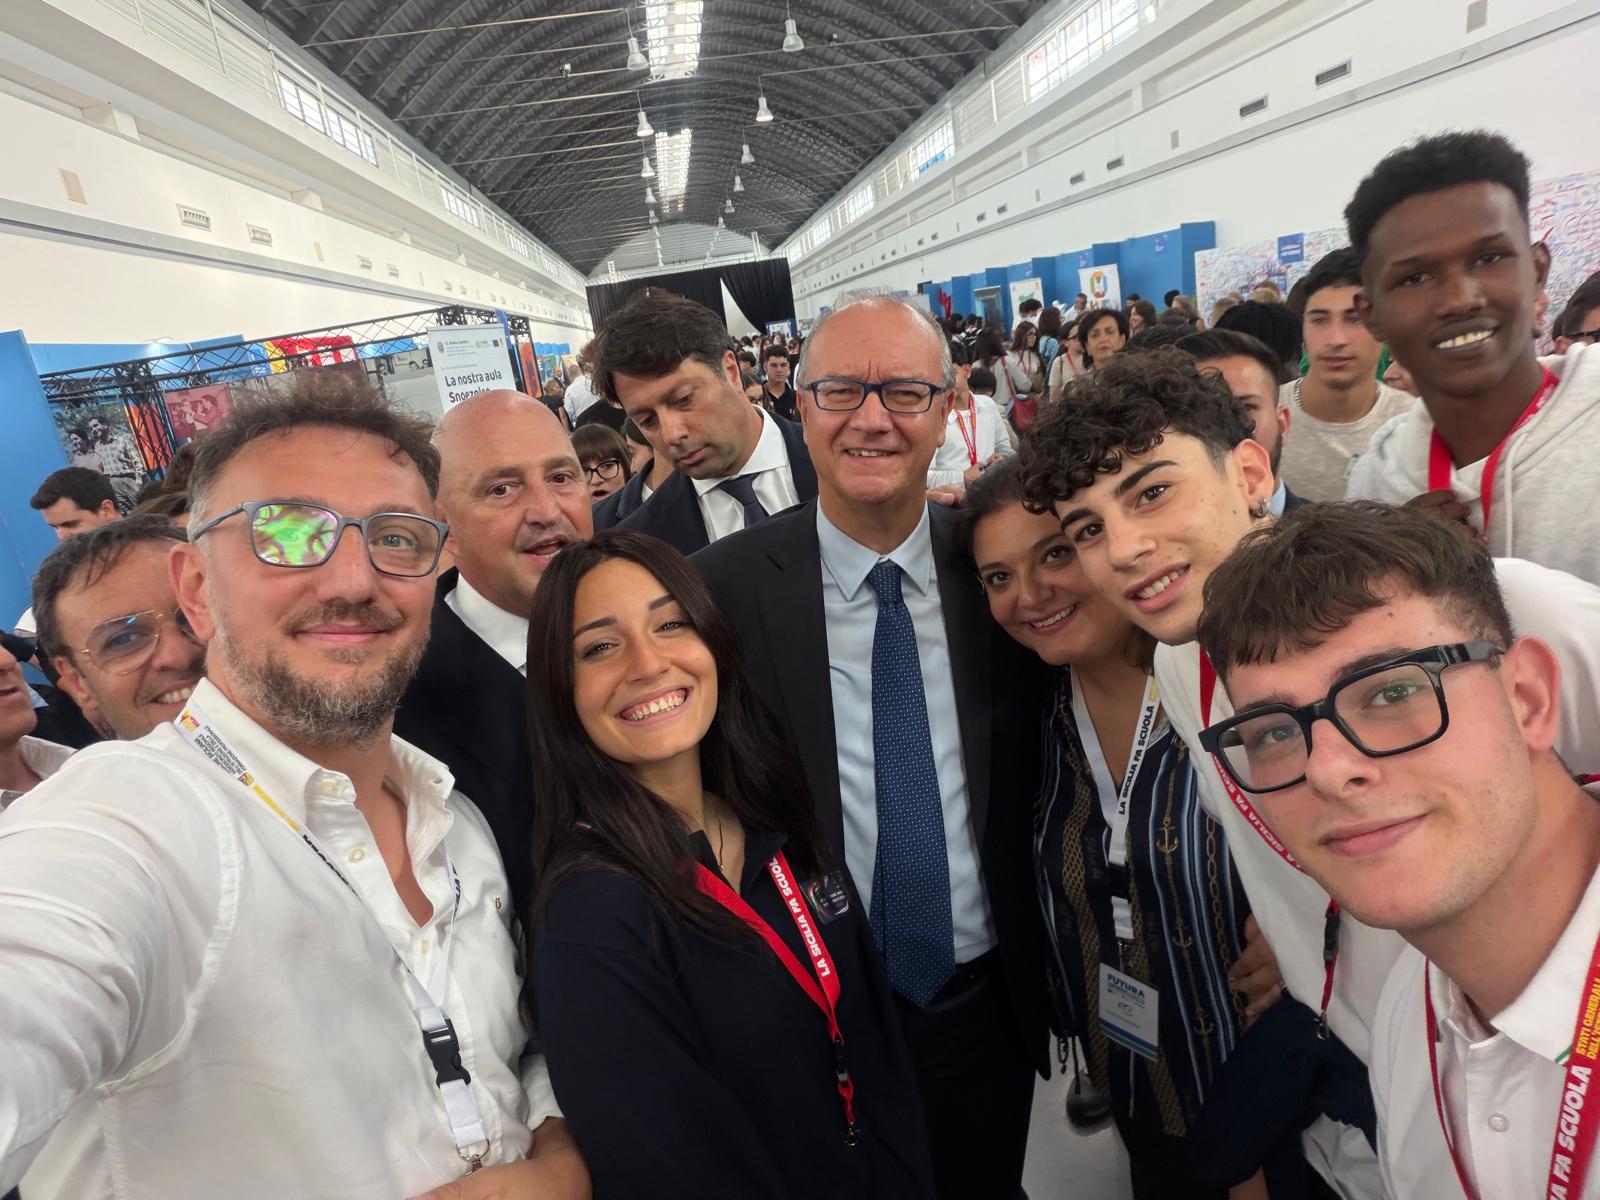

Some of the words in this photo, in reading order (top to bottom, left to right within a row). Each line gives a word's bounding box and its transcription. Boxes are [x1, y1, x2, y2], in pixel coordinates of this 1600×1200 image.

[445, 376, 456, 387] La
[458, 373, 484, 386] nostra
[484, 369, 502, 381] aula
[1139, 705, 1154, 747] SCUOLA
[1134, 749, 1143, 762] FA
[1122, 763, 1138, 798] SICILIA
[1119, 801, 1126, 815] LA
[768, 856, 793, 897] SCUOL
[789, 898, 801, 913] FA
[798, 914, 821, 957] SICILIA
[817, 958, 831, 977] LA
[1107, 973, 1145, 998] FUTURA
[1576, 1027, 1591, 1055] STATI
[1558, 1065, 1592, 1152] SCUOLA
[1553, 1154, 1572, 1183] FA
